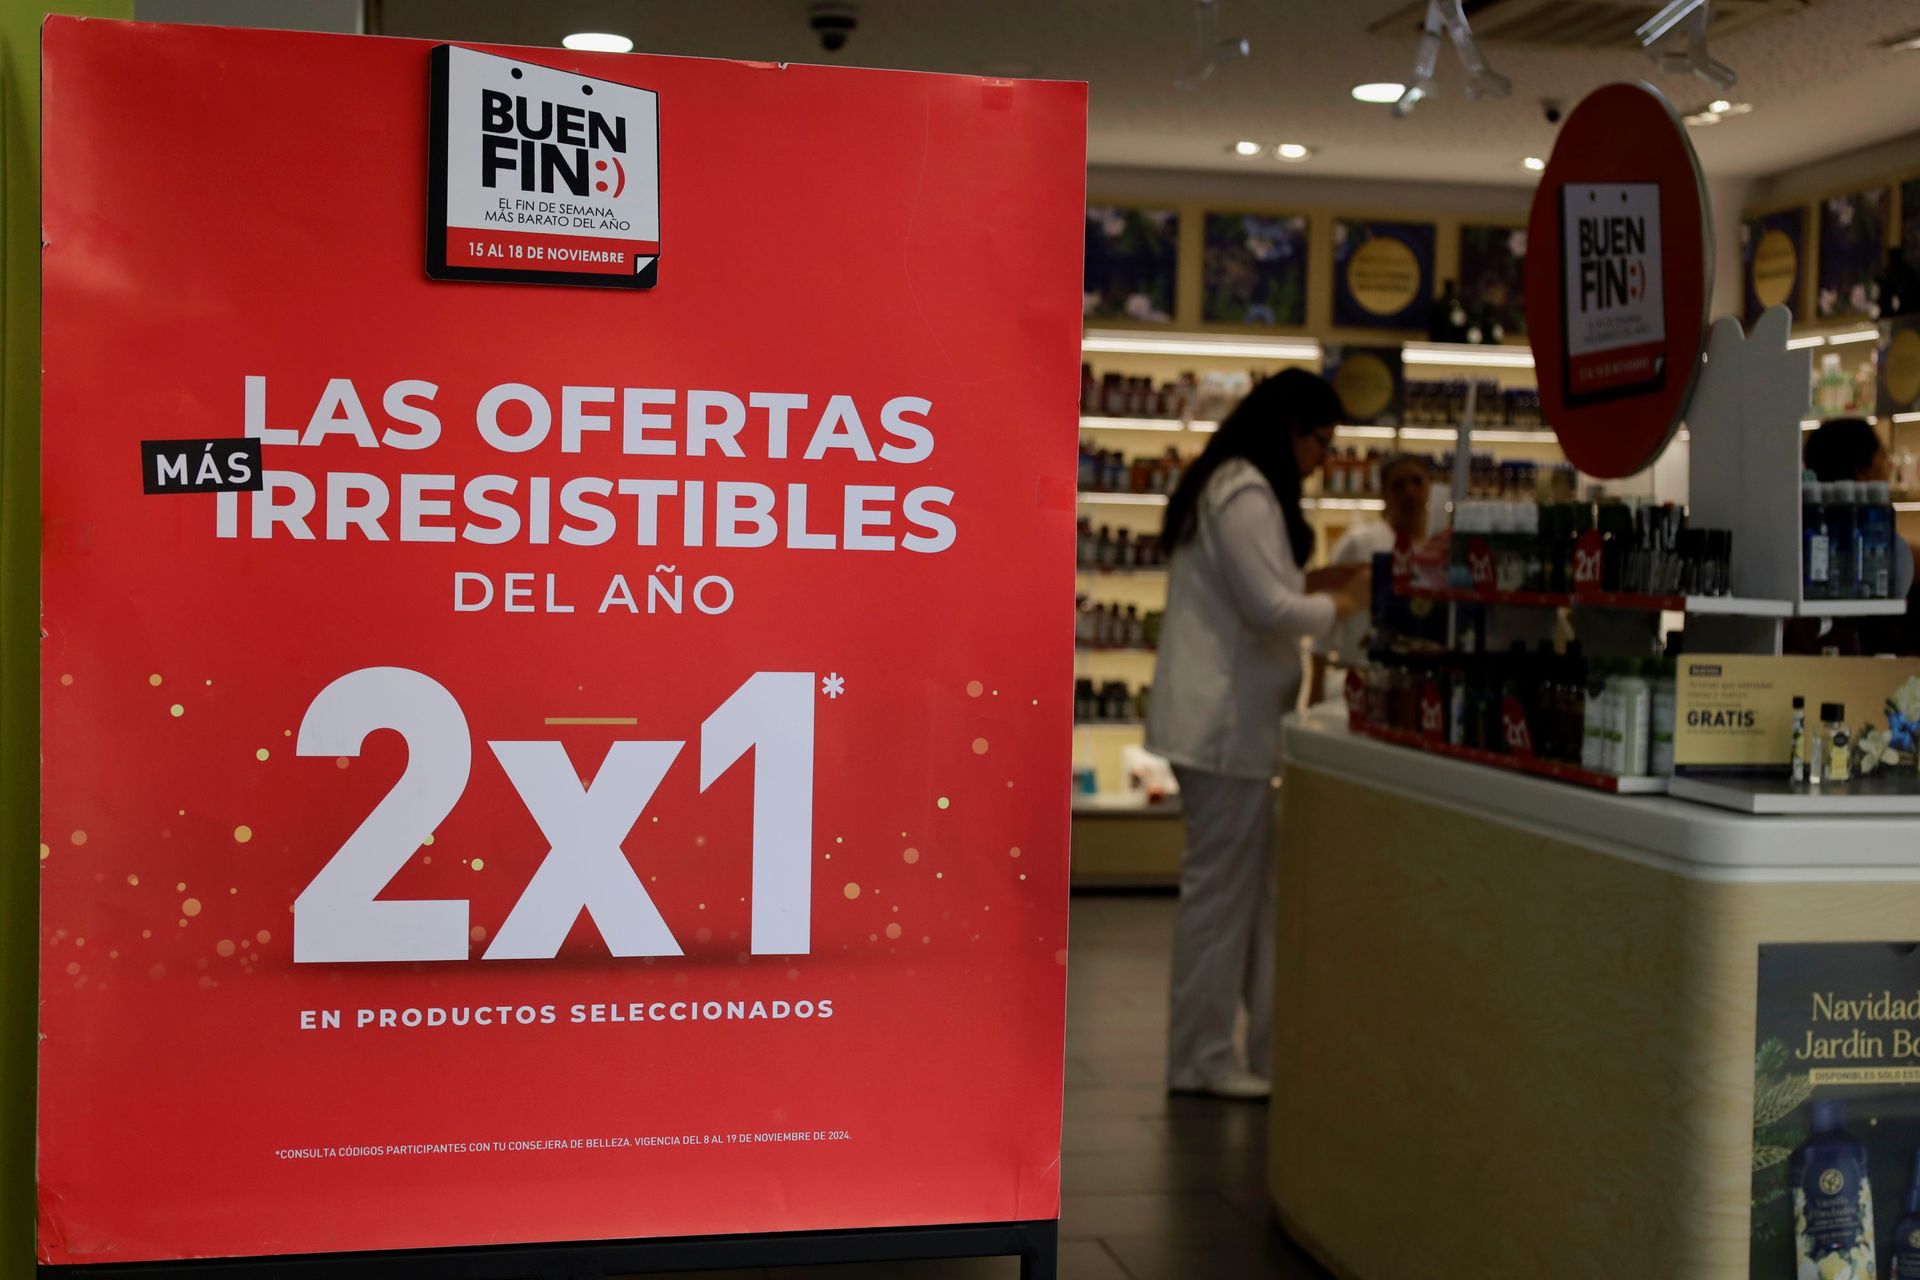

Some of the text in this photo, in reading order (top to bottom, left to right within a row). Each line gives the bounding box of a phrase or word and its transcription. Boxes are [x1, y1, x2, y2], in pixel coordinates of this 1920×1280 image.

[482, 88, 627, 154] BUEN
[484, 209, 631, 231] MÁS BARATO DEL AÑO
[499, 198, 615, 218] EL FIN DE SEMANA
[469, 241, 625, 263] 15 AL 18 DE NOVIEMBRE
[1579, 216, 1646, 258] BUEN
[244, 375, 935, 464] LAS OFERTAS
[156, 442, 252, 486] MÁS
[216, 471, 957, 554] IRRESISTIBLES
[1575, 549, 1602, 583] 2x1
[455, 565, 735, 615] DEL AÑO
[300, 999, 833, 1030] EN PRODUCTOS SELECCIONADOS
[1811, 989, 1920, 1022] Navidad
[1795, 1027, 1885, 1060] Jardín
[338, 1145, 384, 1157] CÓDIGOS
[387, 1142, 467, 1155] PARTICIPANTES
[469, 1142, 491, 1152] CON
[493, 1142, 506, 1151] TU
[508, 1140, 568, 1150] CONSEJERA
[571, 1139, 584, 1149] DE
[586, 1138, 632, 1148] BELLEZA.
[634, 1136, 681, 1146] VIGENCIA
[683, 1135, 702, 1145] DEL
[703, 1135, 710, 1144] 8
[711, 1135, 724, 1144] AL
[727, 1134, 737, 1143] 19
[739, 1133, 752, 1143] DE
[754, 1132, 811, 1142] NOVIEMBRE
[813, 1131, 826, 1141] DE
[828, 1130, 852, 1141] 2024.
